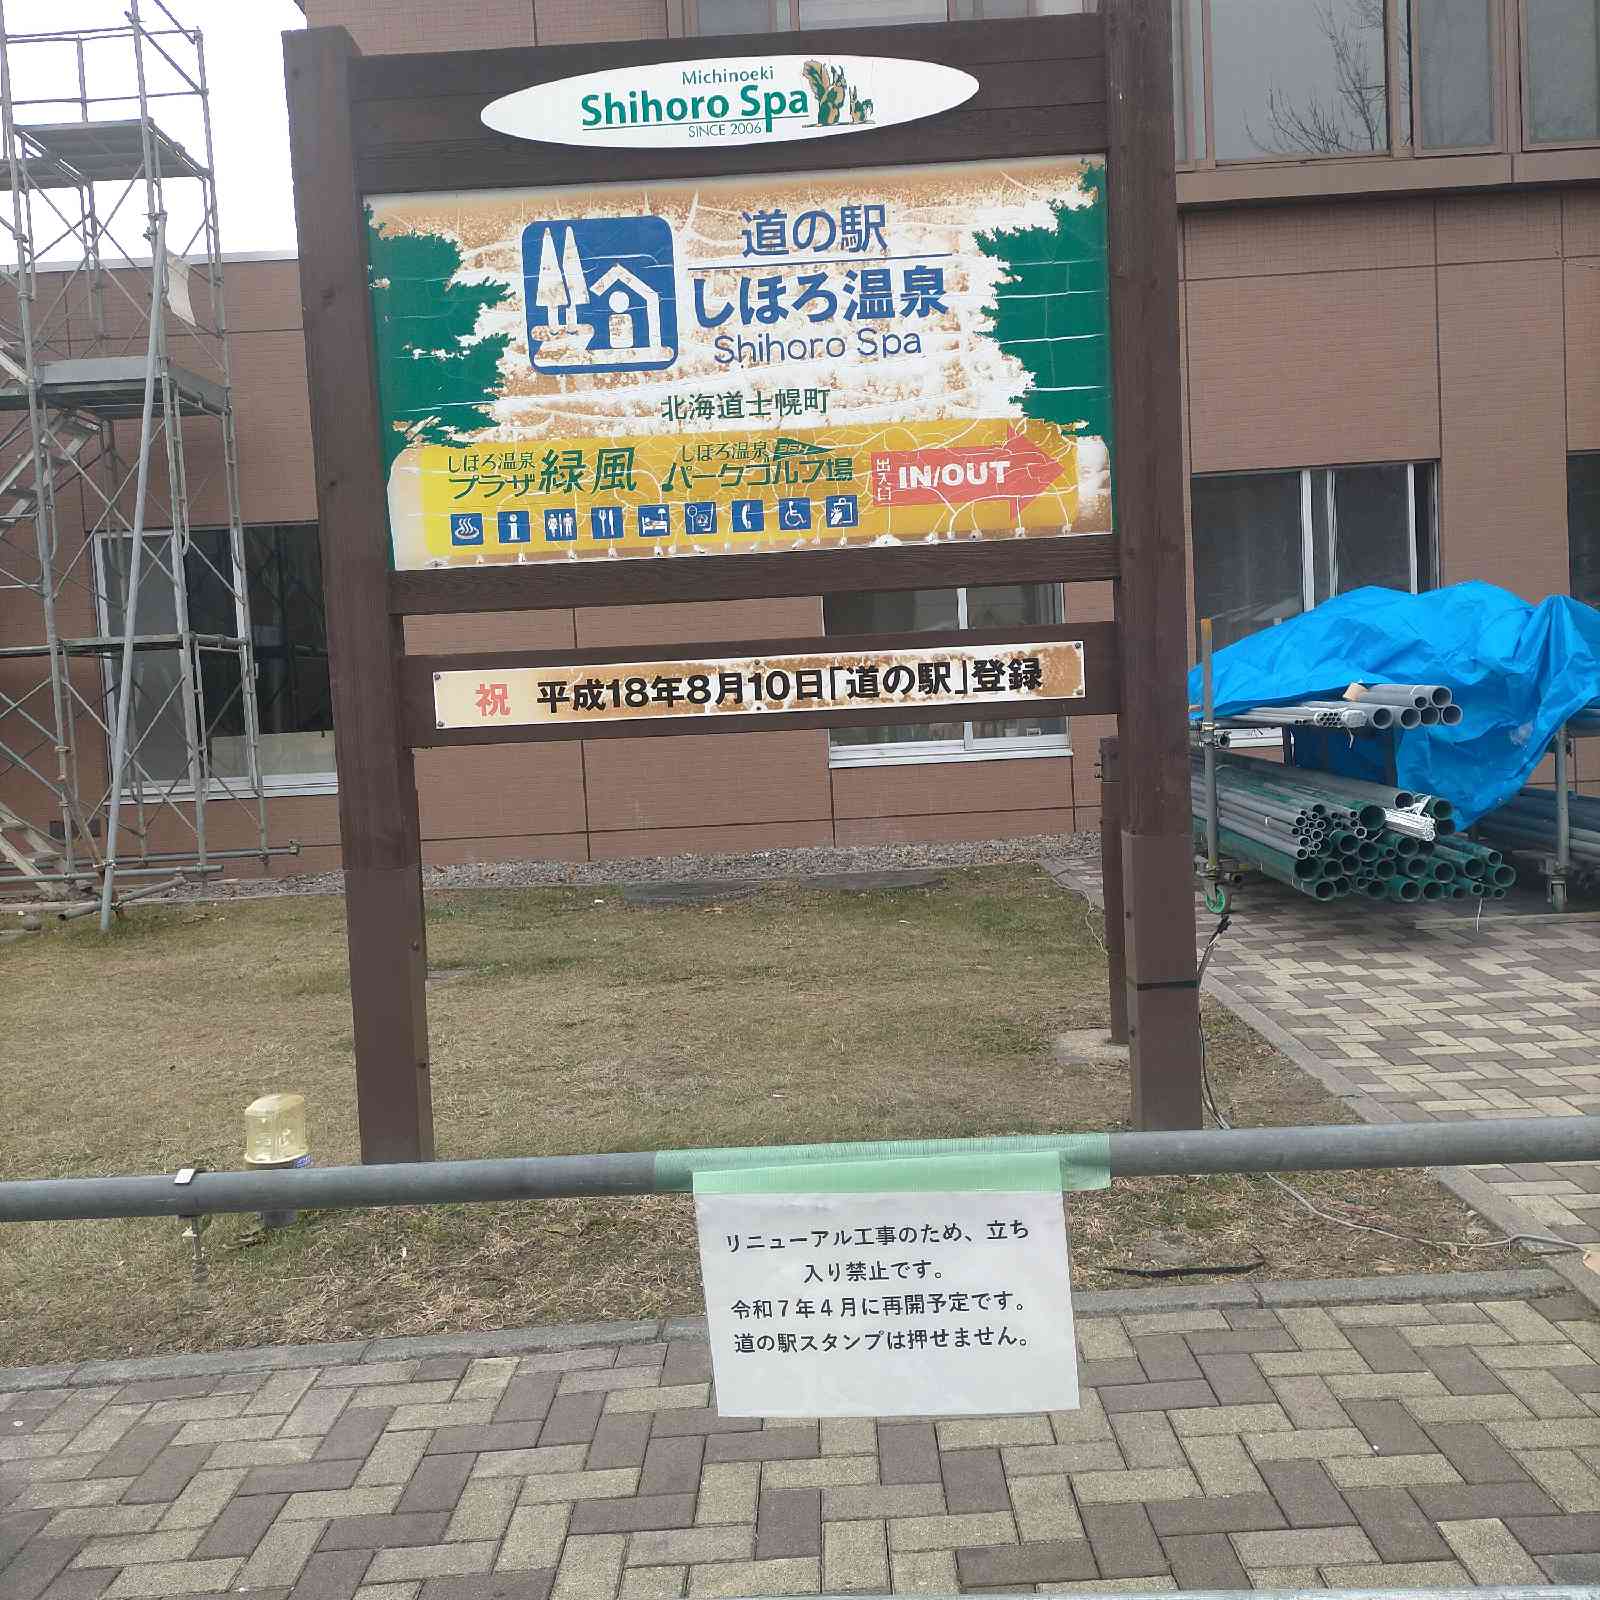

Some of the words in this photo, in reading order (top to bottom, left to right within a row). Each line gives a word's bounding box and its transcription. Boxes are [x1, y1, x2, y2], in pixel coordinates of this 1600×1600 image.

[682, 65, 774, 86] Michinoeki
[581, 90, 730, 126] Shihoro
[740, 84, 809, 132] Spa
[688, 124, 726, 137] SINCE
[731, 121, 762, 136] 2006
[741, 204, 888, 257] 道の駅
[693, 265, 949, 327] しほろ温泉
[714, 332, 846, 364] Shihoro
[857, 328, 922, 360] Spa
[661, 388, 831, 421] 北海道士幌町
[447, 451, 536, 474] しほろ温泉
[681, 441, 769, 463] しほろ温泉
[538, 447, 637, 495] 緑風
[899, 461, 1010, 489] IN/OUT
[448, 475, 536, 500] プラザ
[475, 683, 512, 717] 祝
[536, 657, 1044, 714] 平成18年8月10日「道の駅」登録
[725, 1219, 1030, 1253] リニューアル工事のため、立ち
[803, 1259, 946, 1284] 入り禁止です。
[734, 1327, 1033, 1354] 道の駅スタンプは押せません。
